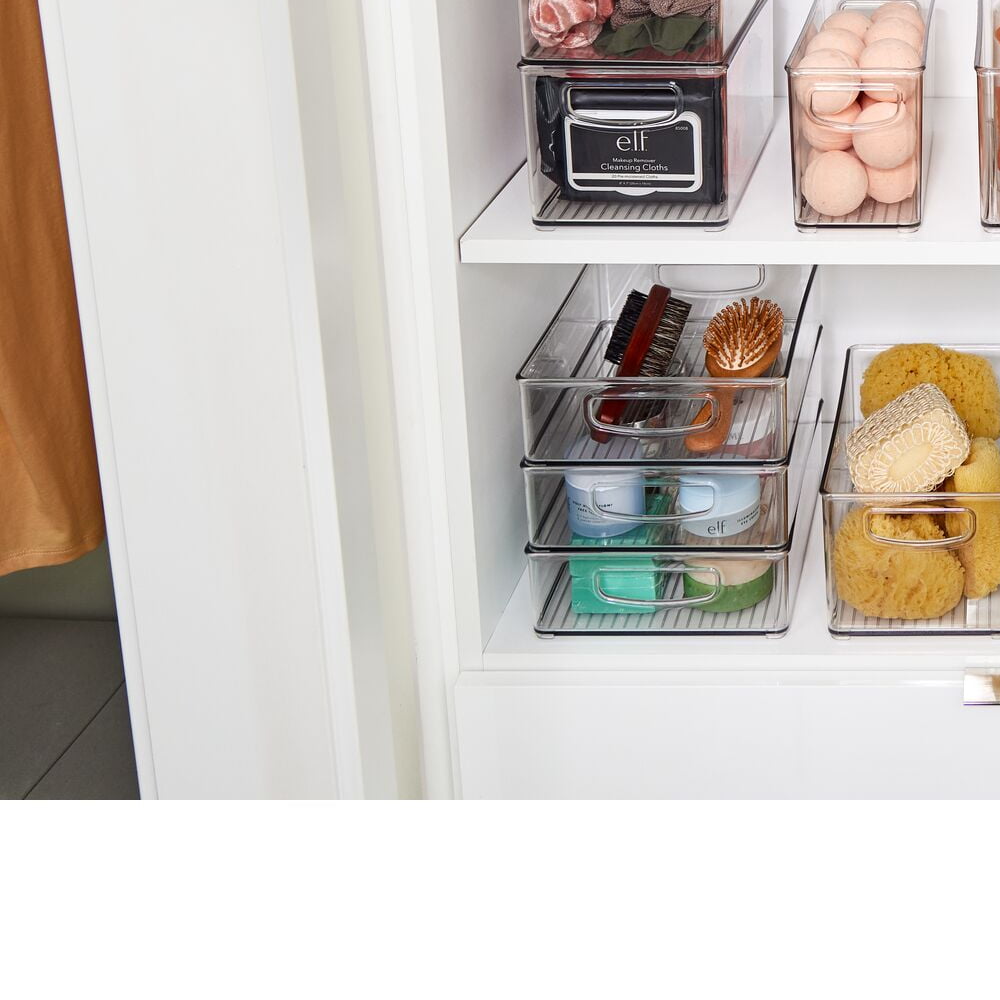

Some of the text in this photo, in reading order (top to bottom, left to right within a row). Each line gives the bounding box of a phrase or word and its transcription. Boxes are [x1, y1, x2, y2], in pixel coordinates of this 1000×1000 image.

[600, 163, 669, 173] Cleansing Cloths
[707, 519, 727, 535] elf
